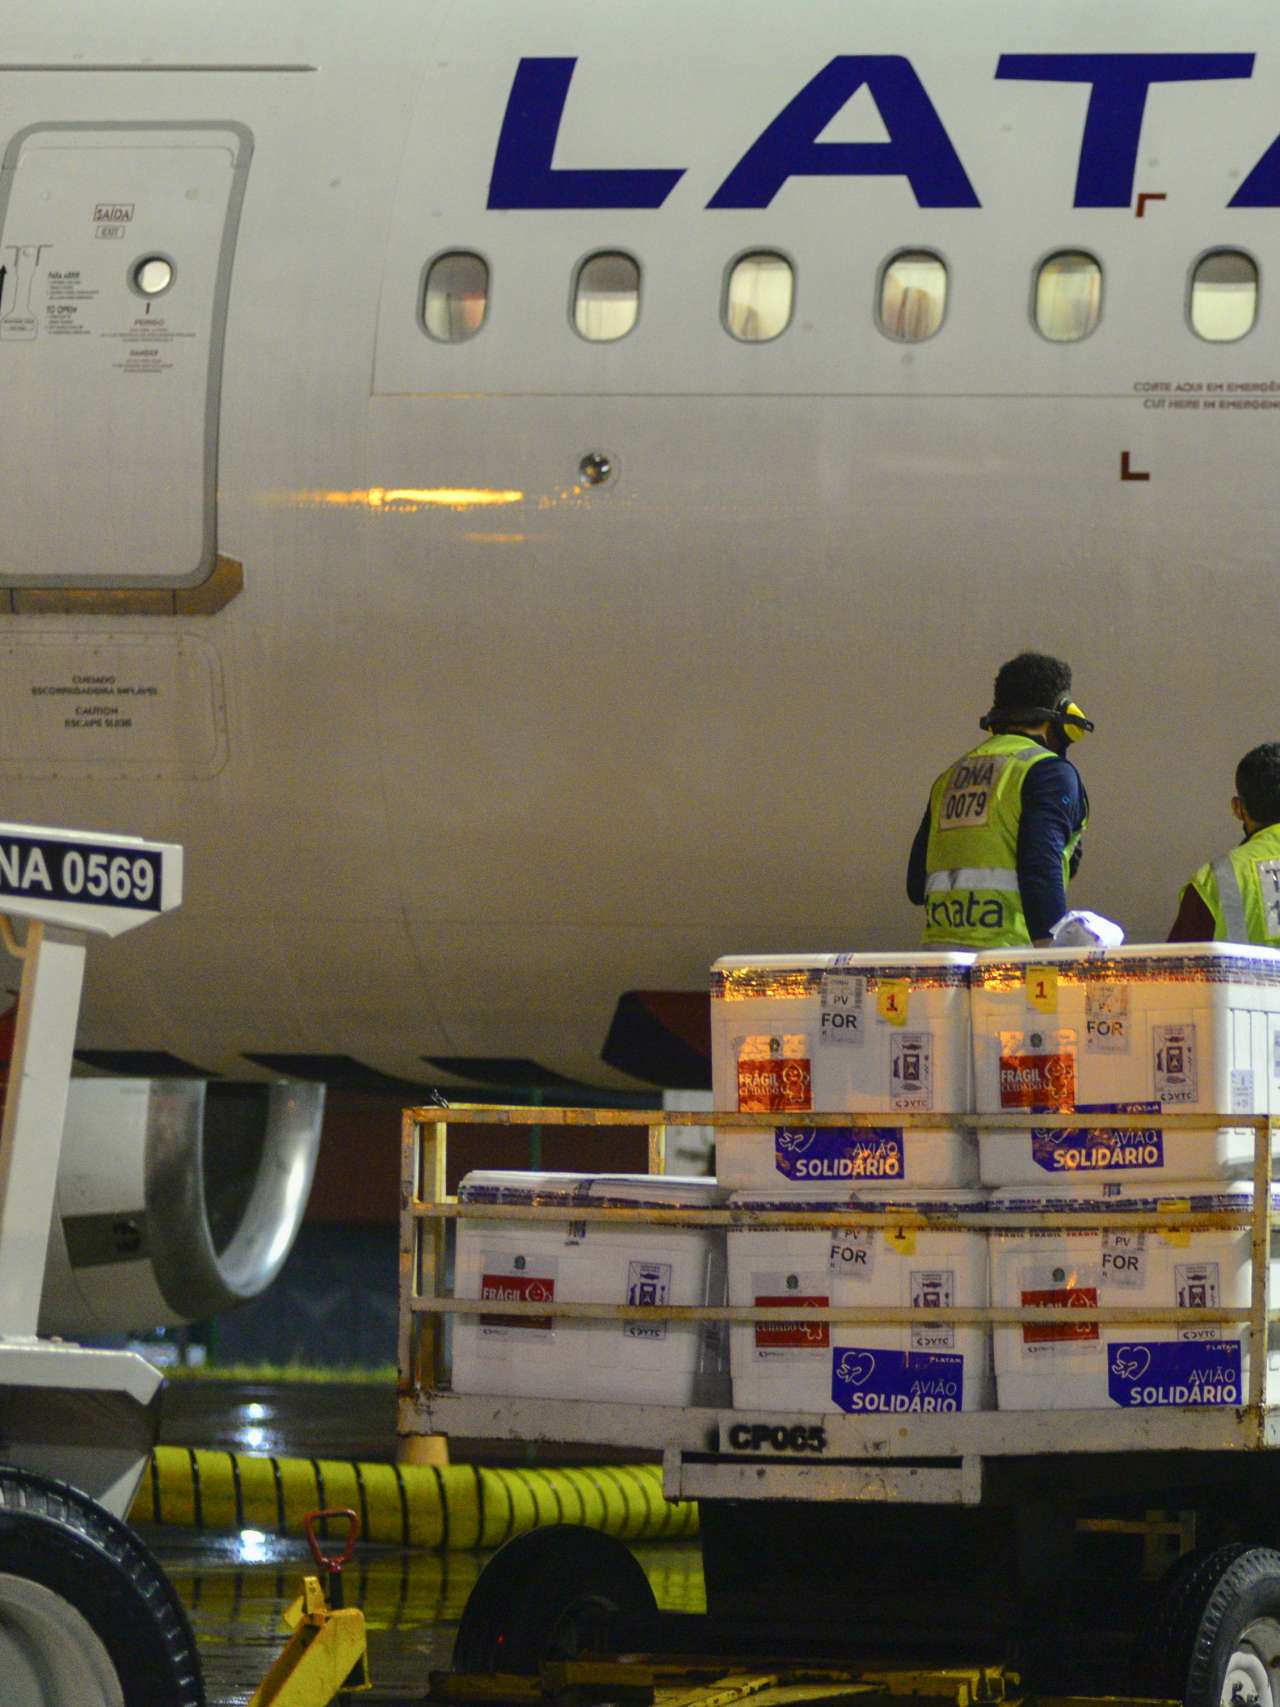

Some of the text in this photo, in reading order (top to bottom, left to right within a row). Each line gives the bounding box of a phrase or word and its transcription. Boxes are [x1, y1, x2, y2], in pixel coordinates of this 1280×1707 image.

[1134, 382, 1171, 392] CORTE
[1175, 382, 1203, 392] AQUI
[1206, 382, 1224, 392] EM
[1144, 399, 1165, 410] CUT
[1168, 399, 1199, 410] HERE
[1203, 399, 1216, 410] IN
[953, 763, 994, 789] DNA
[946, 791, 986, 820] 0079
[62, 851, 154, 901] 0569
[926, 890, 1004, 929] nata
[821, 1012, 857, 1029] FOR
[1087, 1021, 1125, 1036] FOR
[1054, 1143, 1159, 1168] SOLIDÁRIO
[795, 1155, 900, 1177] SOLIDÁRIO
[830, 1246, 867, 1264] FOR
[1102, 1253, 1139, 1271] FOR
[1188, 1366, 1236, 1383] AVIÃO
[911, 1379, 957, 1396] AVIÃO
[1130, 1381, 1238, 1405] SOLIDÁRIO
[851, 1391, 958, 1413] SOLIDÁRIO
